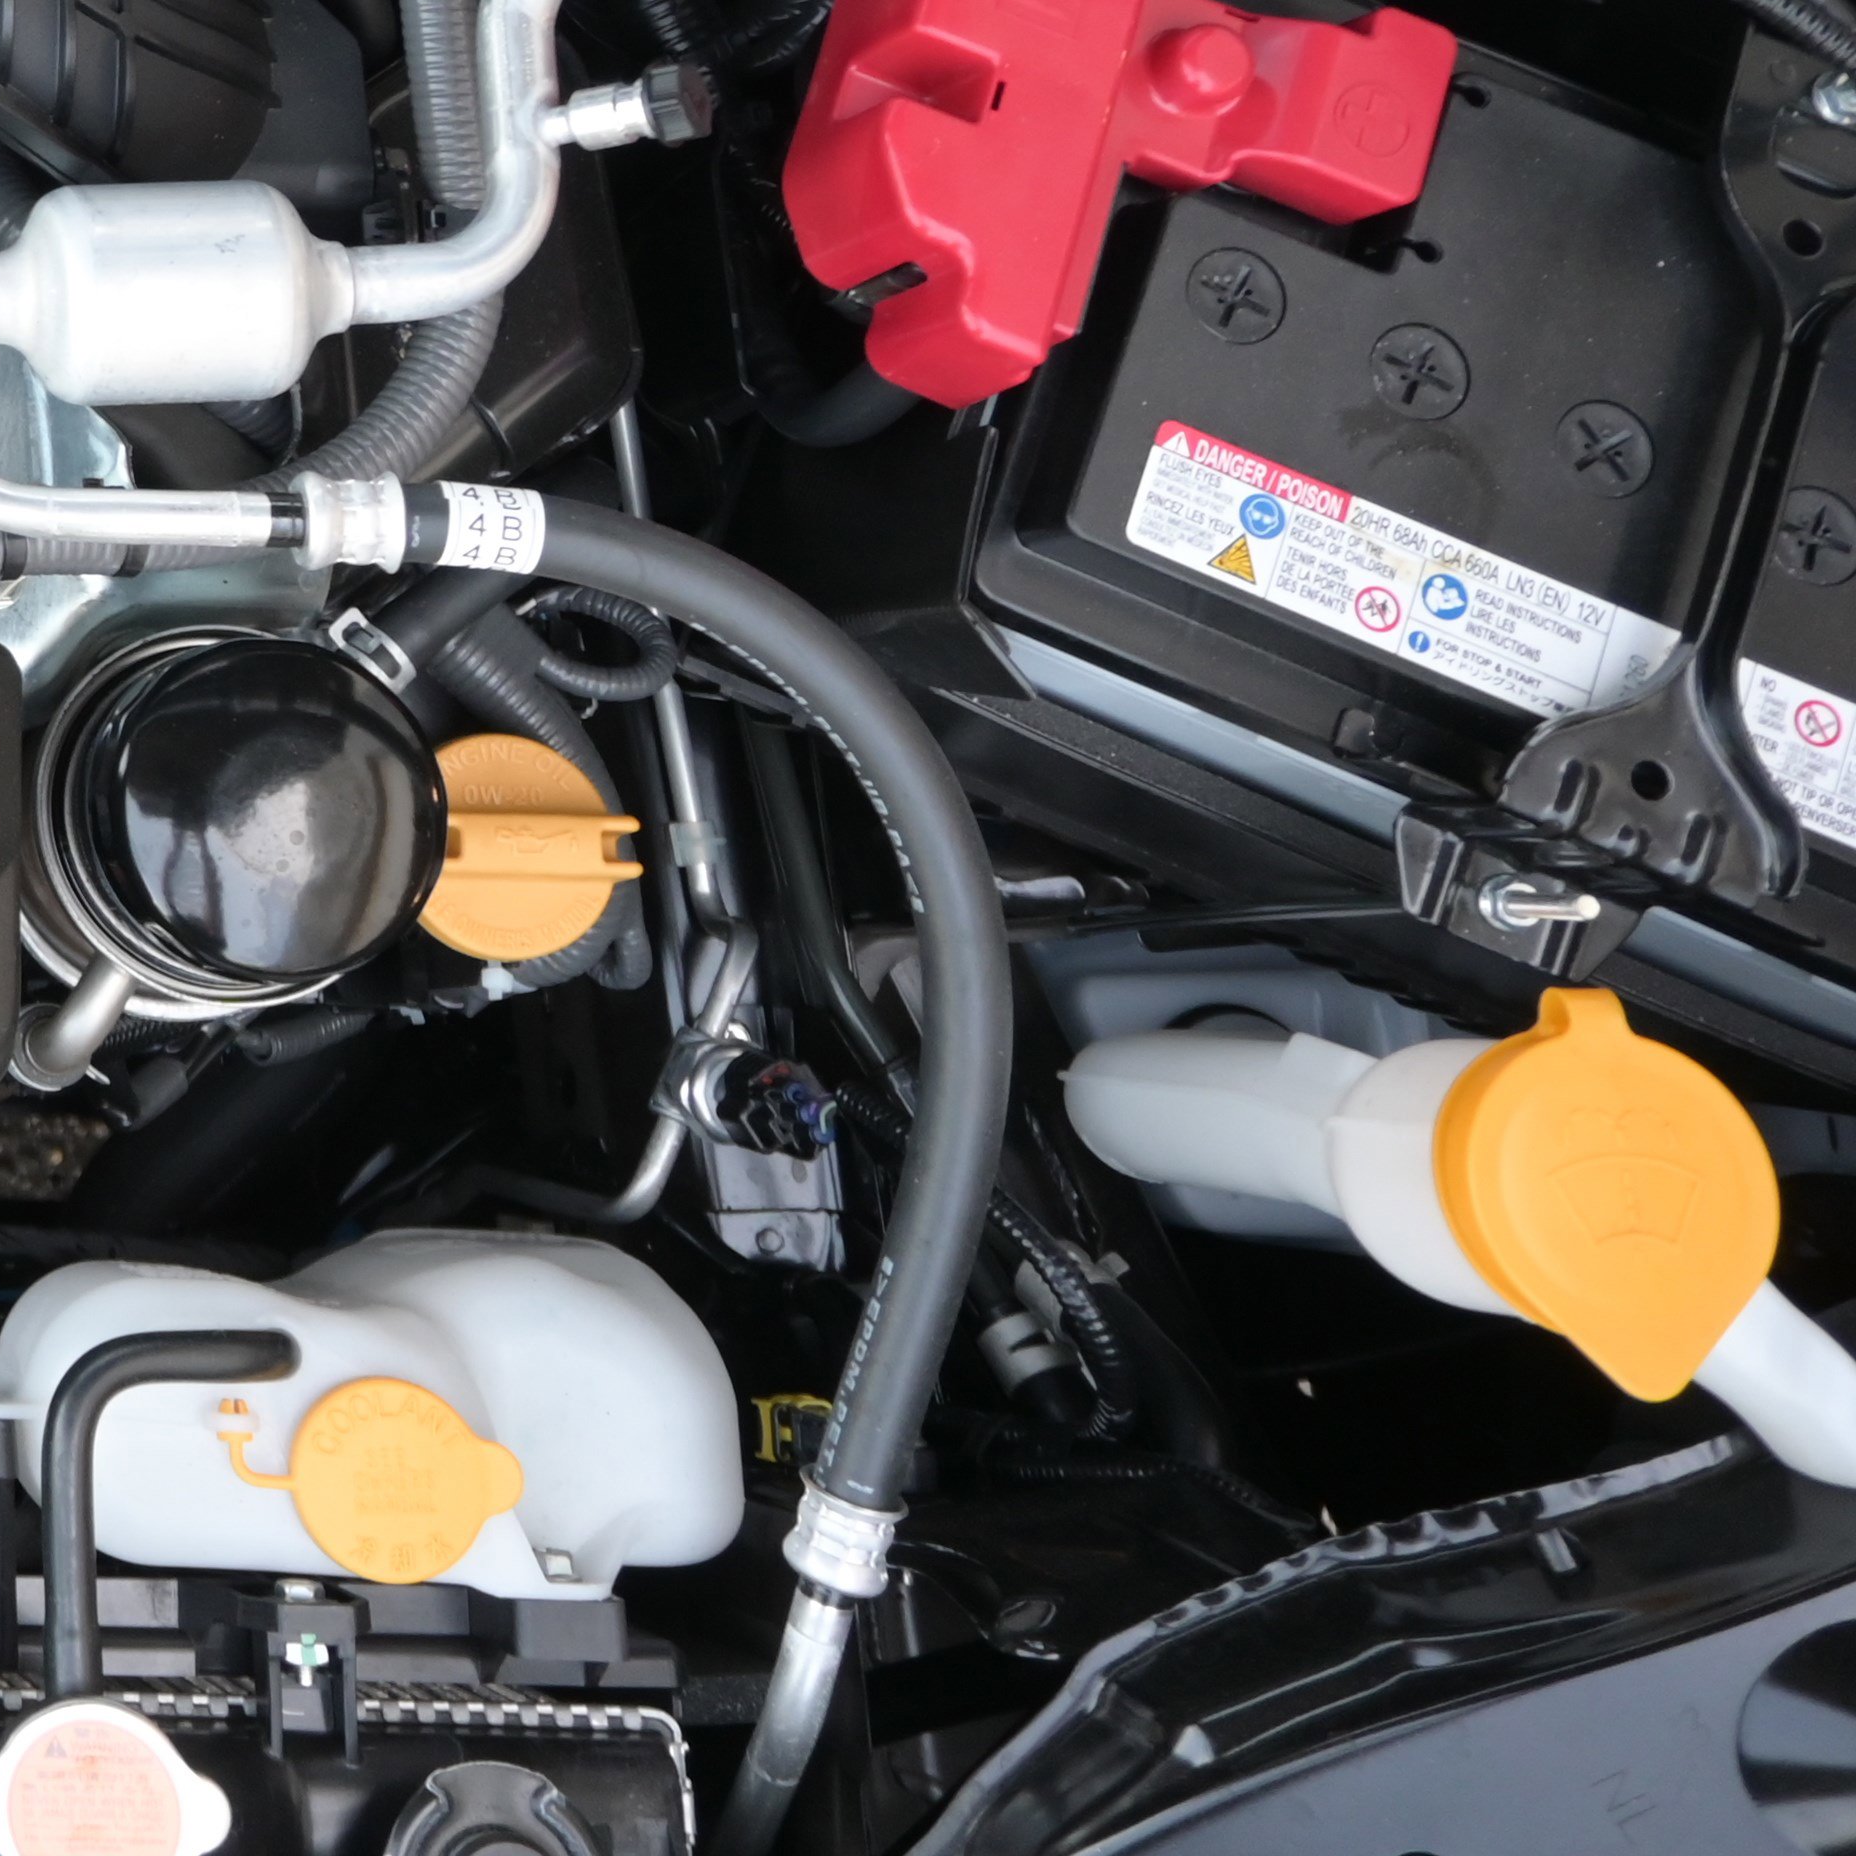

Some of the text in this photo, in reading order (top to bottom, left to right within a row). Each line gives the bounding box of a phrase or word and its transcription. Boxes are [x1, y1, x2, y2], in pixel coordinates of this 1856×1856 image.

[1158, 452, 1194, 477] FLUSH
[1192, 466, 1223, 490] EYES
[1194, 439, 1267, 485] DANGER
[1277, 475, 1347, 519] POISON
[469, 514, 521, 540] 4 B
[1144, 490, 1183, 515] RINCEZ
[1182, 506, 1207, 526] LES
[1205, 516, 1235, 538] YEUX
[1292, 510, 1386, 559] KEEP OUT OF THE
[1279, 559, 1295, 576] DE
[1296, 567, 1313, 583] LA
[1284, 544, 1349, 582] TENIR HORS
[1288, 525, 1398, 583] REACH OF CHILDREN
[1348, 502, 1606, 628] 20HR 68Ah CCA 660A LN3 (EN) 12V
[1274, 573, 1348, 616] DES ENFANTS
[1473, 588, 1584, 645] READ INSTRUCTIONS
[1464, 619, 1542, 663] INSTRUCTIONS
[1468, 604, 1517, 634] LIRE LES
[1434, 636, 1461, 655] FOR
[1461, 647, 1494, 669] STOP
[1505, 665, 1542, 689] START
[1757, 675, 1778, 694] NO
[446, 742, 578, 791] NGINE OIL
[466, 788, 543, 804] 0W-20
[1798, 784, 1818, 802] TIP
[1817, 793, 1835, 809] OR
[313, 1391, 459, 1453] COOLANT
